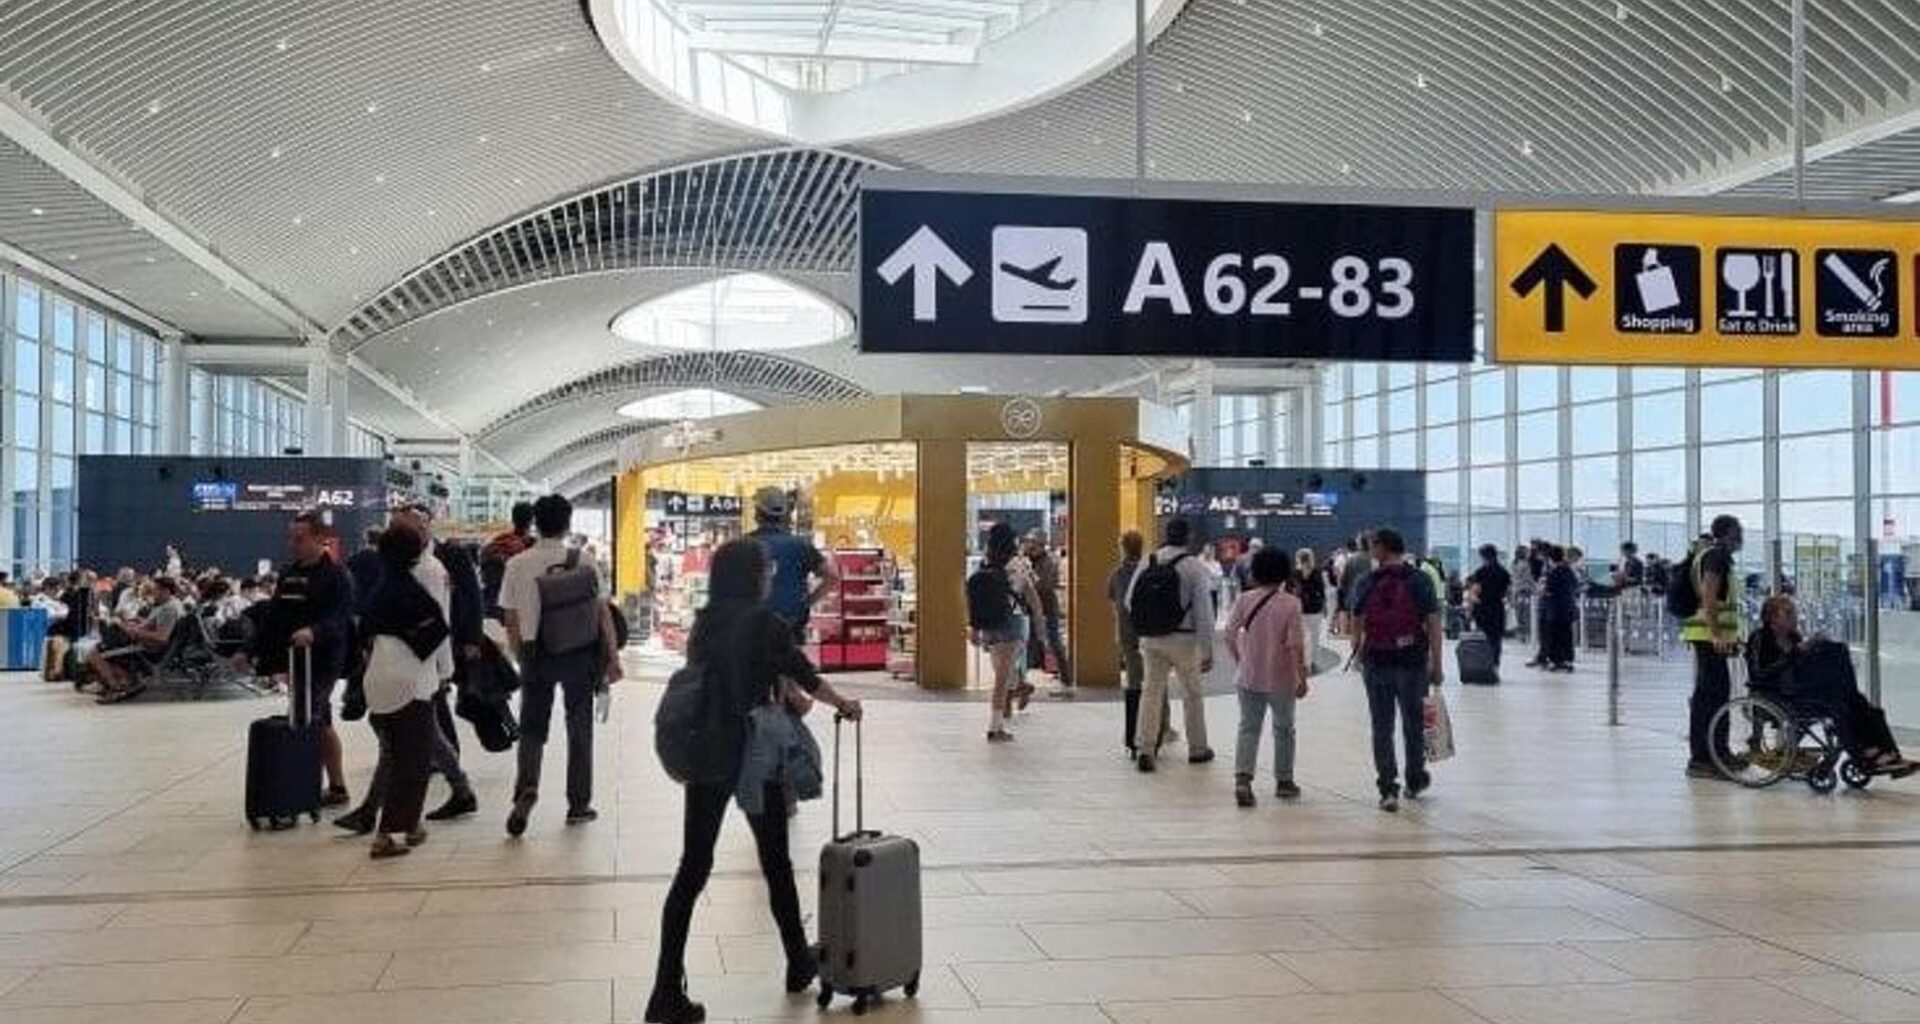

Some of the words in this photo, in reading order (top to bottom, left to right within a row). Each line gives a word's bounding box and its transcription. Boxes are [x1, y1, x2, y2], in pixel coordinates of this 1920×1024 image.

[1622, 314, 1694, 331] Shopping
[1759, 319, 1797, 332] Drink
[1825, 309, 1889, 327] Smoking
[1842, 323, 1874, 333] area
[317, 489, 354, 506] A62
